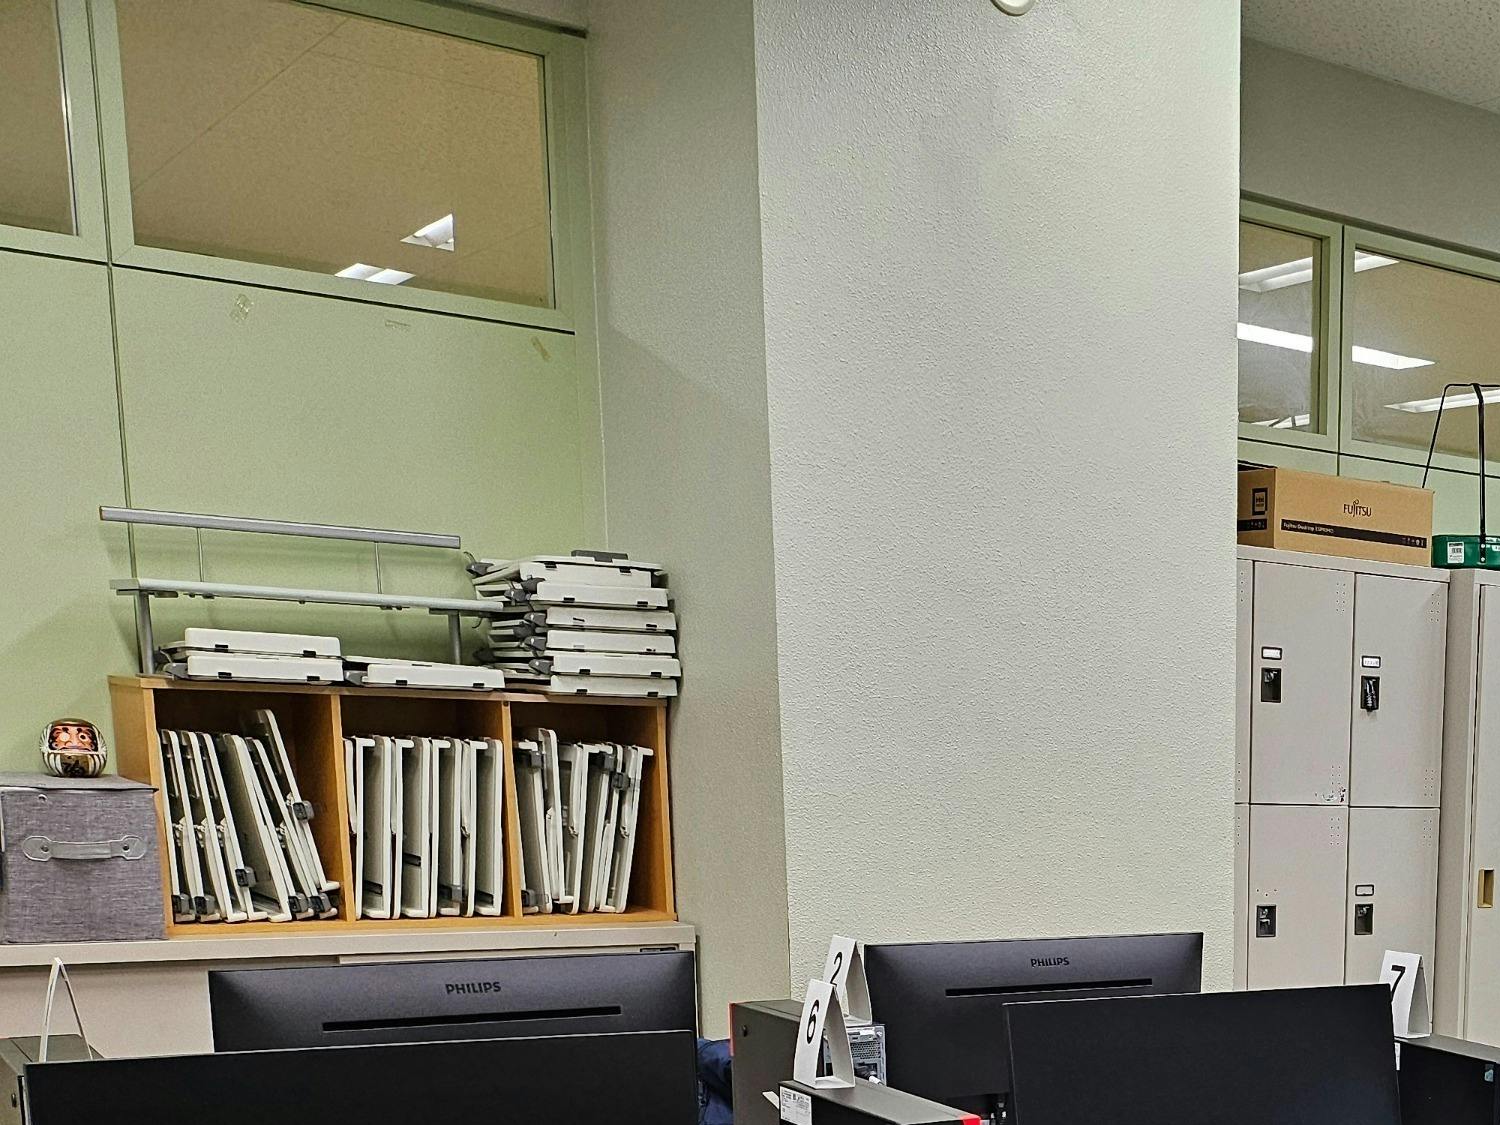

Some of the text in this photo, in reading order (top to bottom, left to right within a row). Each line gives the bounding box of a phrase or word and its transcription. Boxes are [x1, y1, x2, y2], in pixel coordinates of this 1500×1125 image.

[1343, 499, 1372, 517] FUJITSU
[830, 951, 843, 987] 2
[1030, 956, 1070, 968] PHILIPS
[445, 981, 502, 995] PHILIPS
[1391, 964, 1406, 995] 7
[806, 999, 820, 1045] 6
